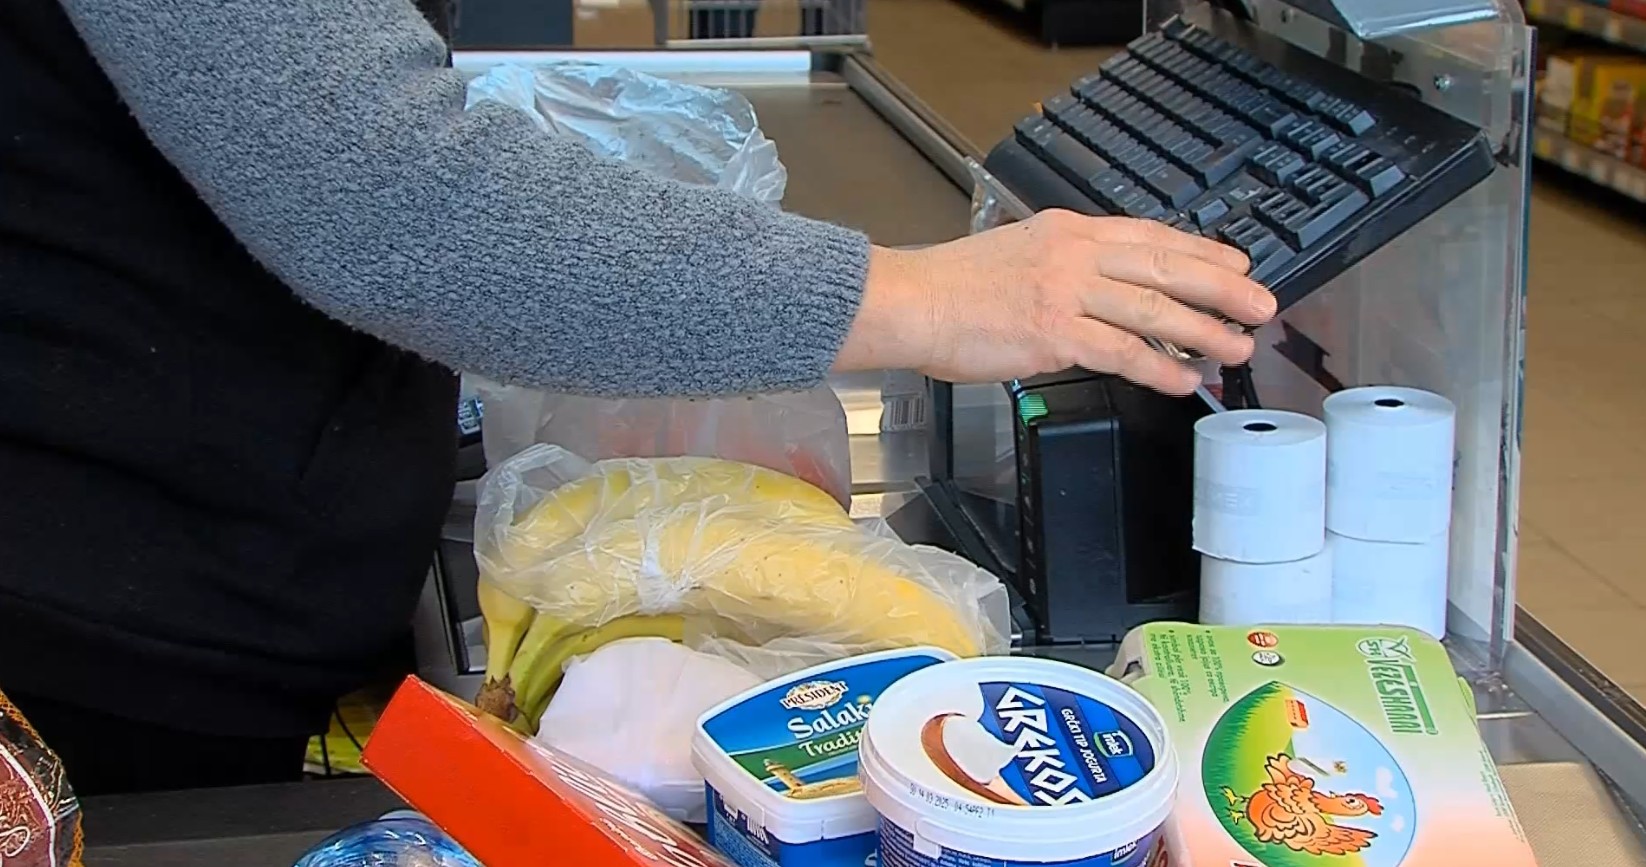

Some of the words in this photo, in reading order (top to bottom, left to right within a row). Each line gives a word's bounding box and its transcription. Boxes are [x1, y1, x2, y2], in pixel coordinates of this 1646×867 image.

[1060, 708, 1082, 733] GRČKI
[1073, 733, 1088, 749] TIP
[1080, 747, 1107, 783] JOGURTA
